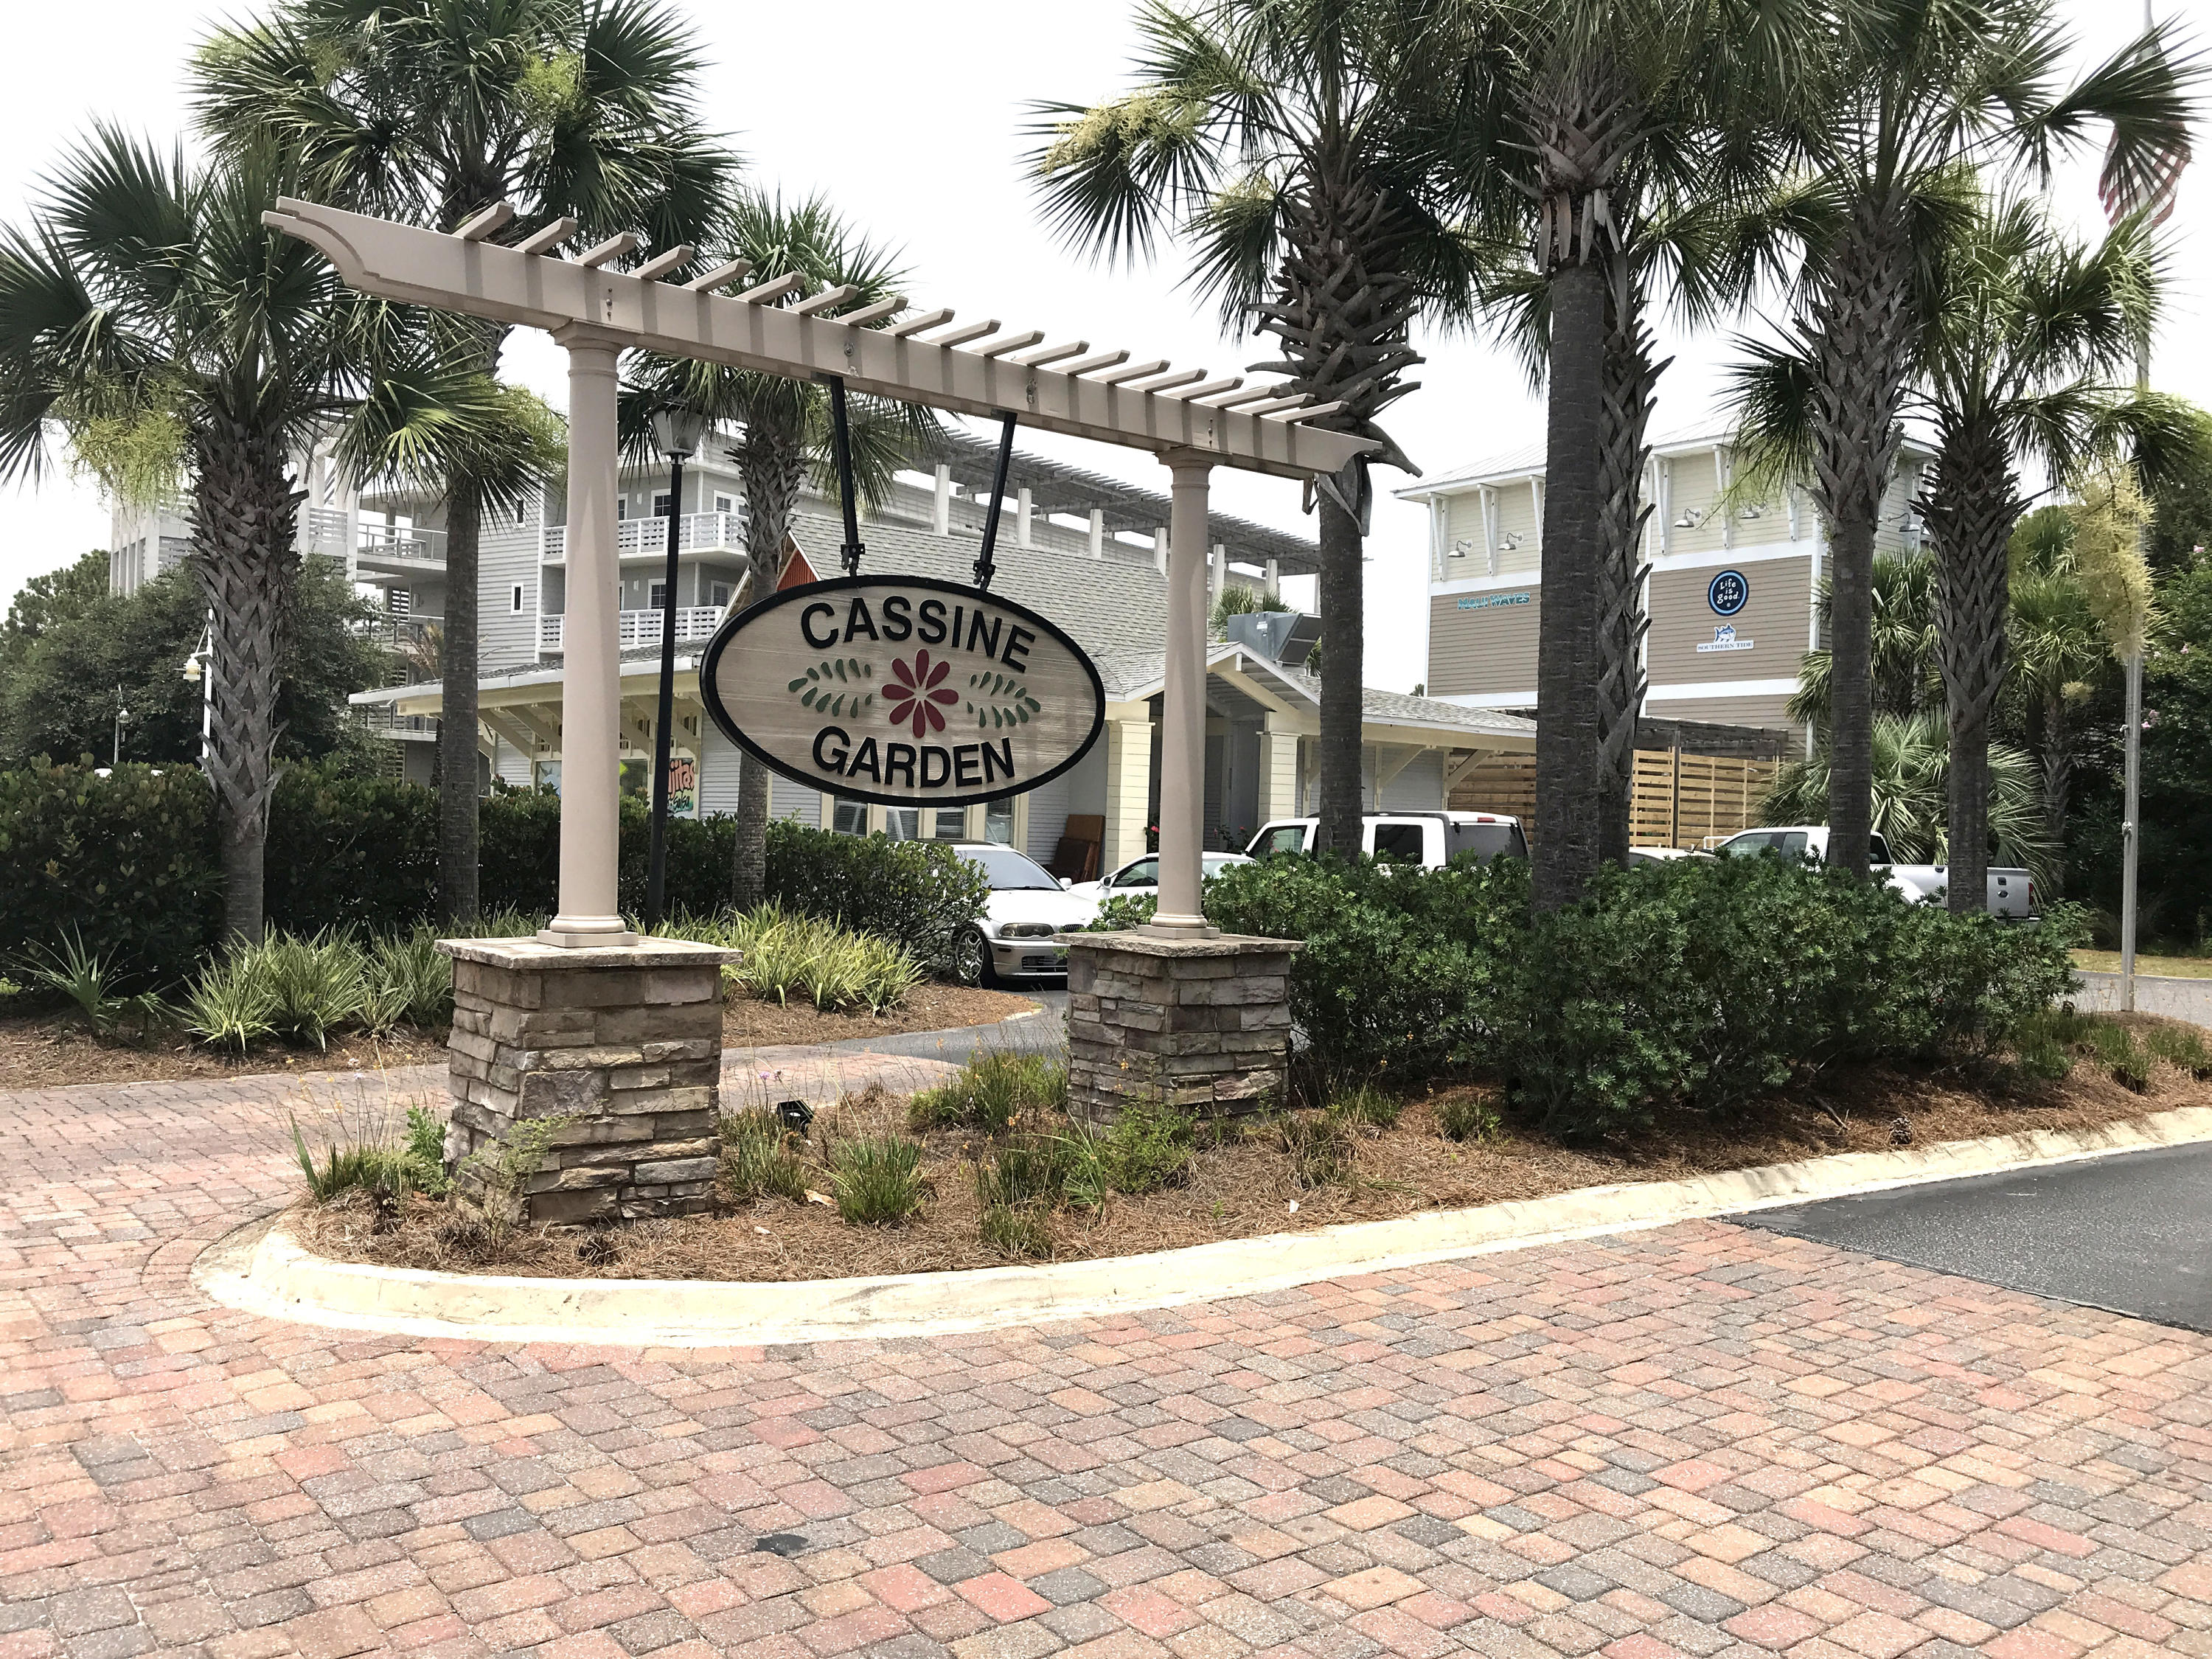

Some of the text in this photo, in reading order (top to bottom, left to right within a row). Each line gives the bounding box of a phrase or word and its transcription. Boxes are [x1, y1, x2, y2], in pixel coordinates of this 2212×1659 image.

[1457, 592, 1531, 611] MAUI WAVES
[1720, 578, 1736, 590] Life
[801, 595, 1036, 673] CASSINE
[812, 726, 1016, 788] GARDEN
